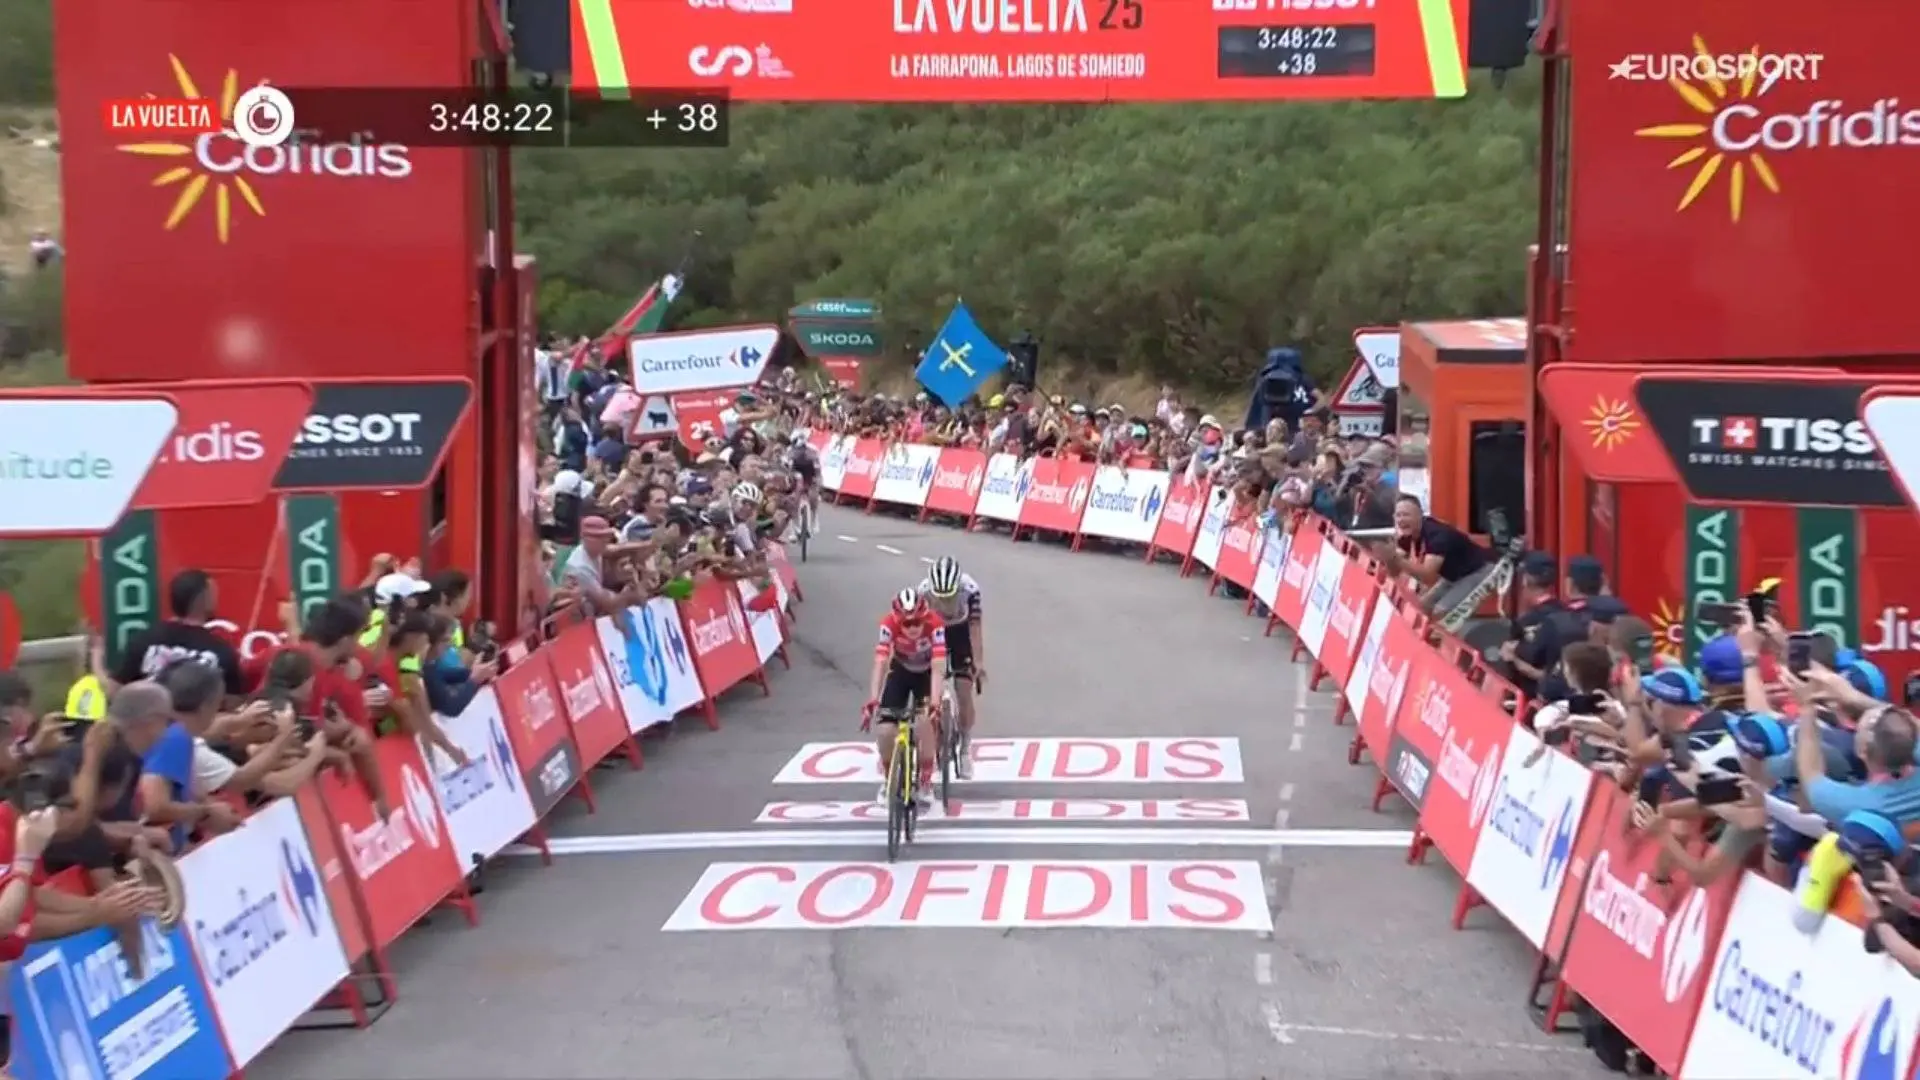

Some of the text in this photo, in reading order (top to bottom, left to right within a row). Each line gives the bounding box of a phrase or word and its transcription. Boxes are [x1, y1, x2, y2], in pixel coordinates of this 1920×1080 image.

[945, 0, 1088, 33] VUELTA
[1257, 27, 1337, 50] 3:48:22
[890, 54, 909, 78] LA
[1007, 53, 1054, 78] LAGOS
[1057, 53, 1076, 78] DE
[1079, 53, 1145, 78] SOMIEDO
[641, 354, 724, 374] Carrefour
[159, 421, 266, 463] idis
[293, 413, 422, 444] SSOT
[0, 451, 114, 480] itude
[1688, 452, 1744, 466] SWISS
[800, 740, 1225, 780] CFIDIS
[699, 864, 1245, 925] COFIDIS
[1712, 938, 1836, 1075] Carrefour
